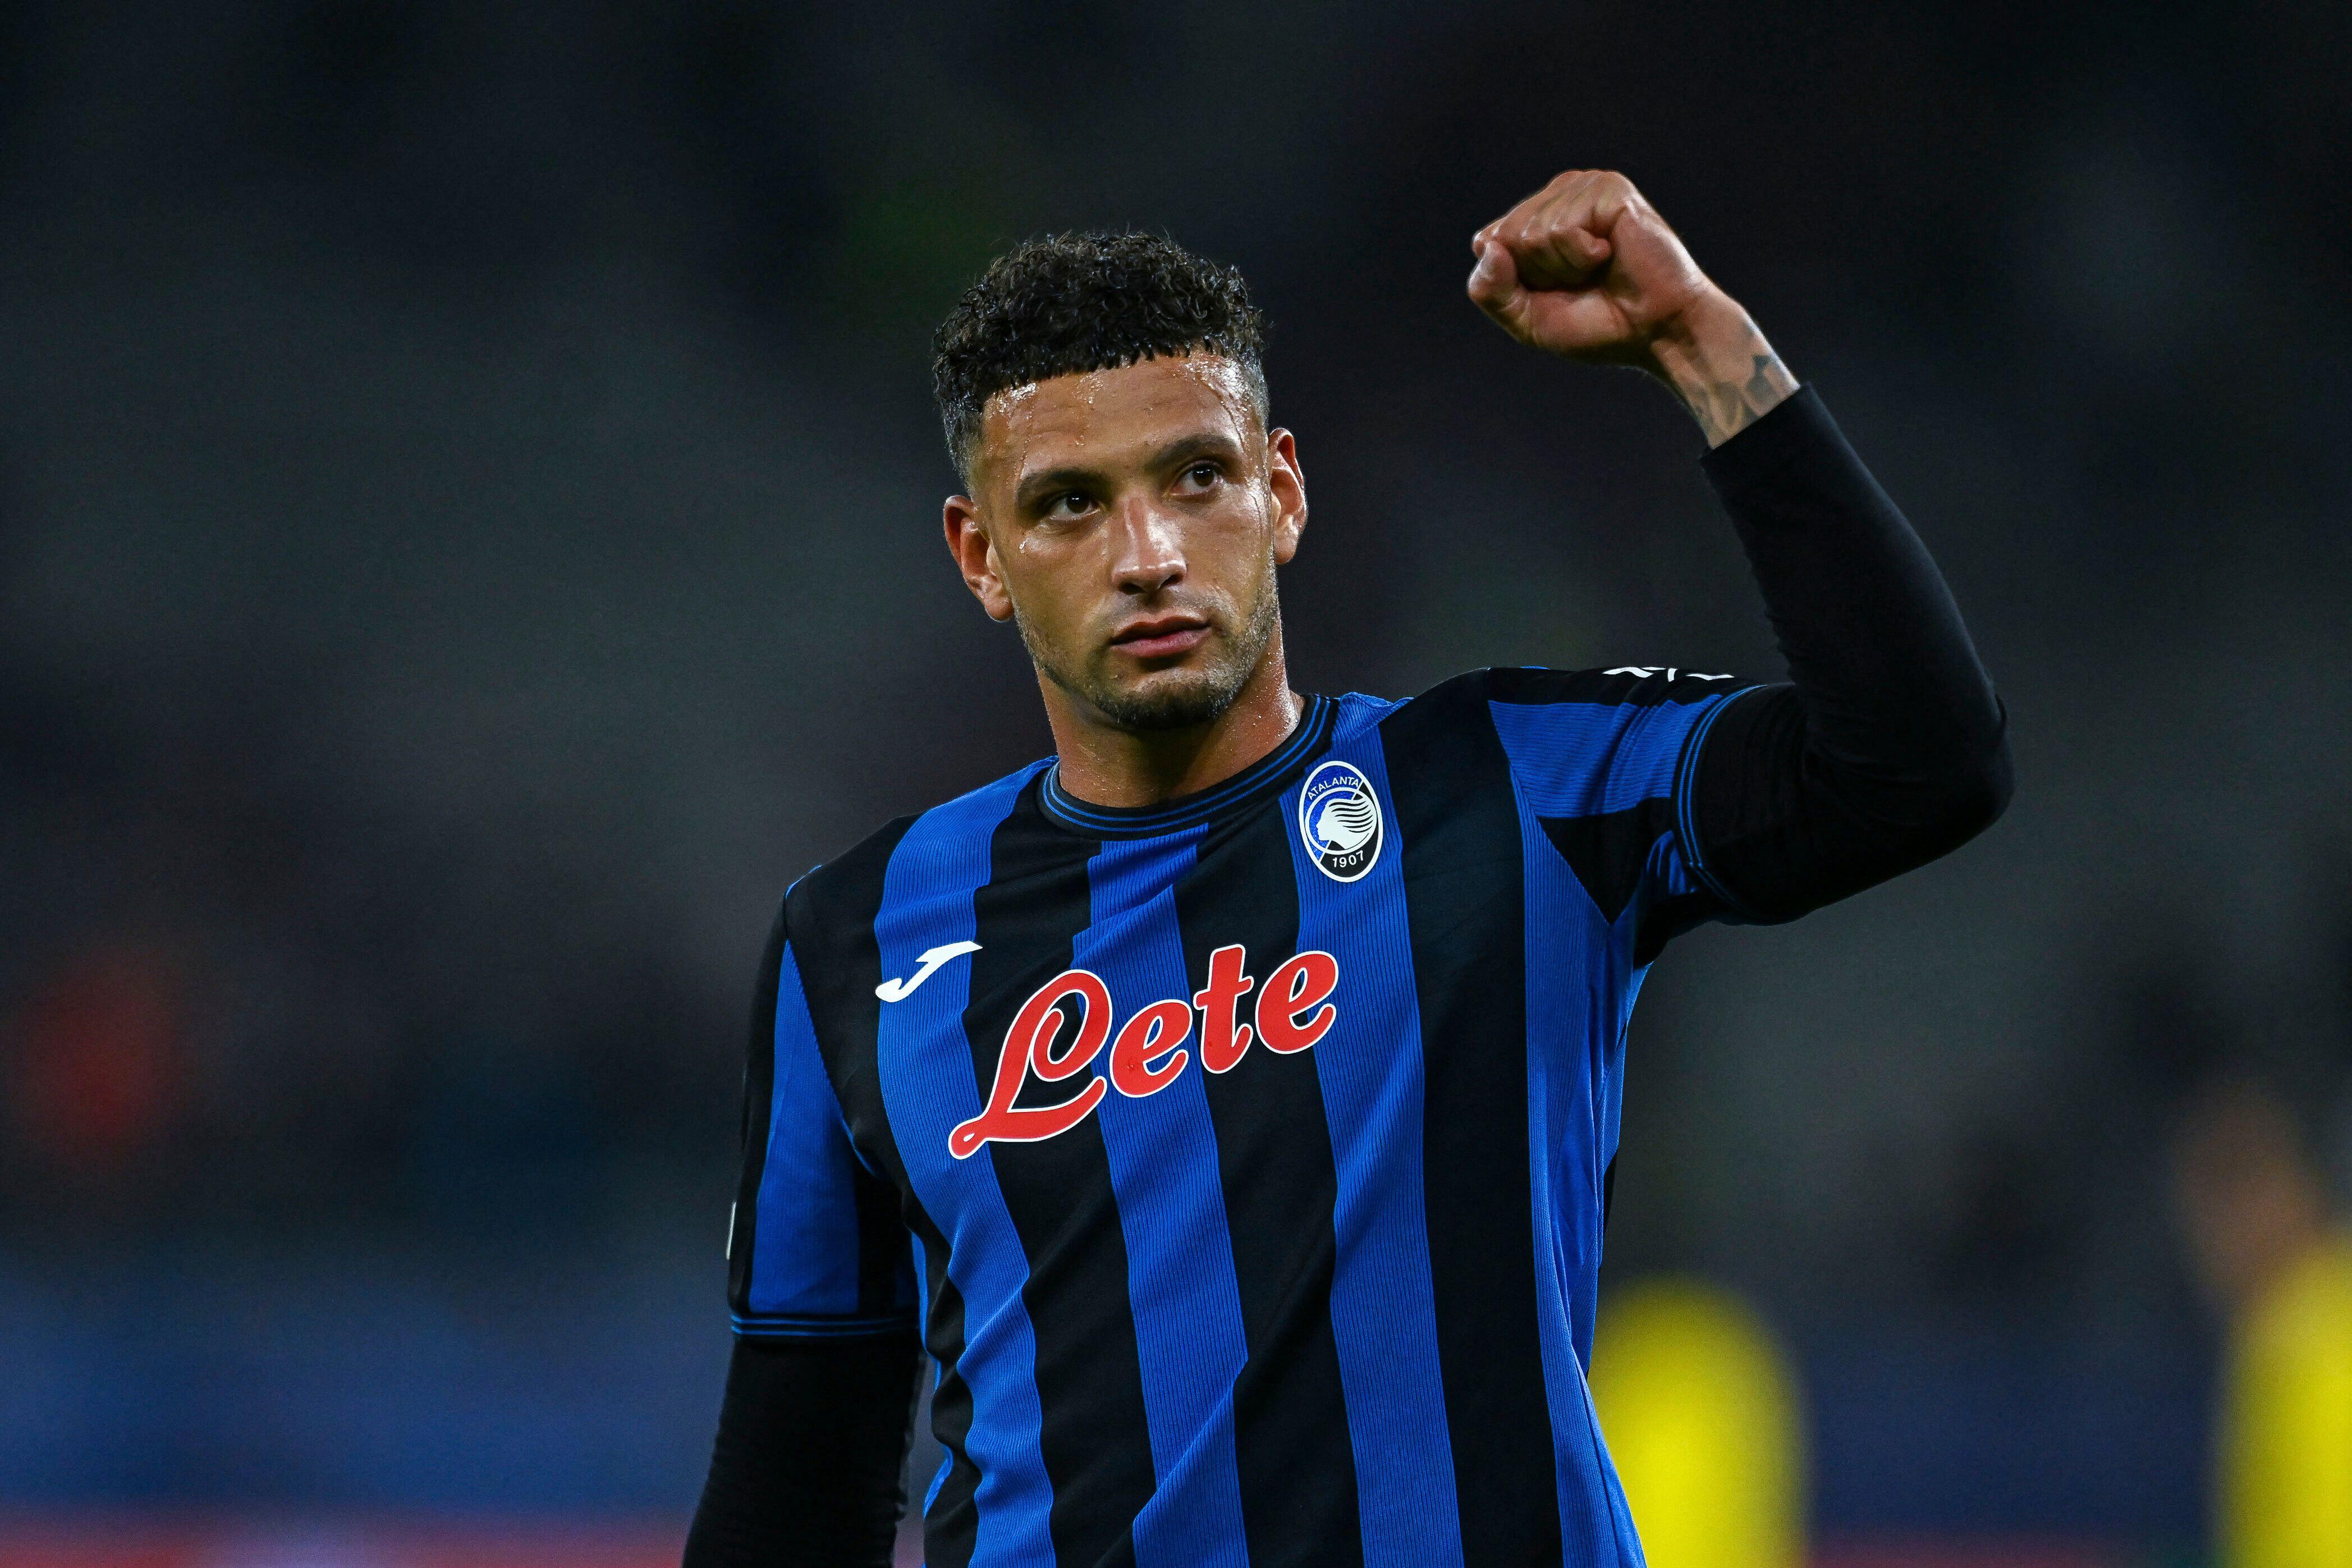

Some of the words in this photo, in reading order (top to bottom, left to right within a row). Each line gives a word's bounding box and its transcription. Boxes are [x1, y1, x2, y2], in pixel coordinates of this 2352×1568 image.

[1307, 776, 1360, 800] ATALANTA
[1332, 850, 1364, 868] 1907
[948, 943, 1339, 1160] Lete
